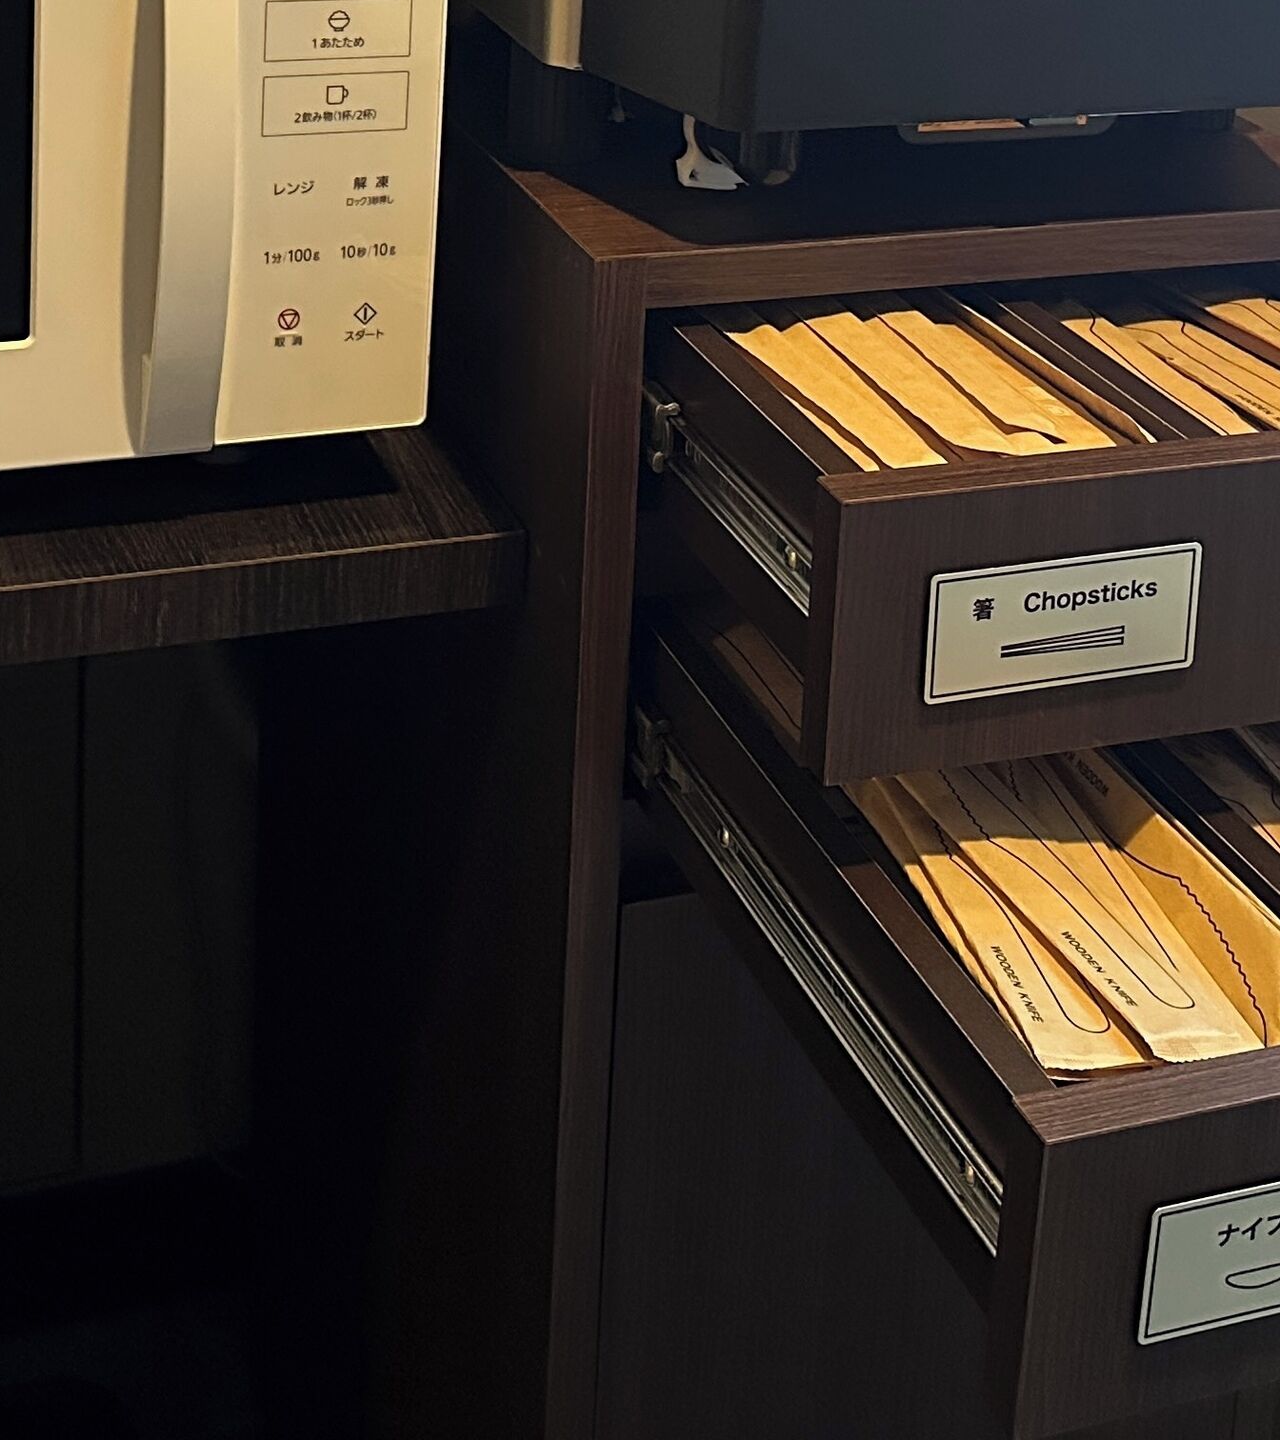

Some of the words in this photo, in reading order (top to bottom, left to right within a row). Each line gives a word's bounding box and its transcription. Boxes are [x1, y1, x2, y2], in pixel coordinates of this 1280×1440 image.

[274, 181, 314, 196] レンジ
[344, 328, 384, 342] スタート
[972, 596, 995, 622] 箸
[1022, 577, 1159, 615] Chopsticks
[991, 945, 1024, 989] WOODEN
[1018, 991, 1044, 1024] KNIFE
[1061, 931, 1106, 974] WOODEN
[1104, 977, 1140, 1007] KNIFE
